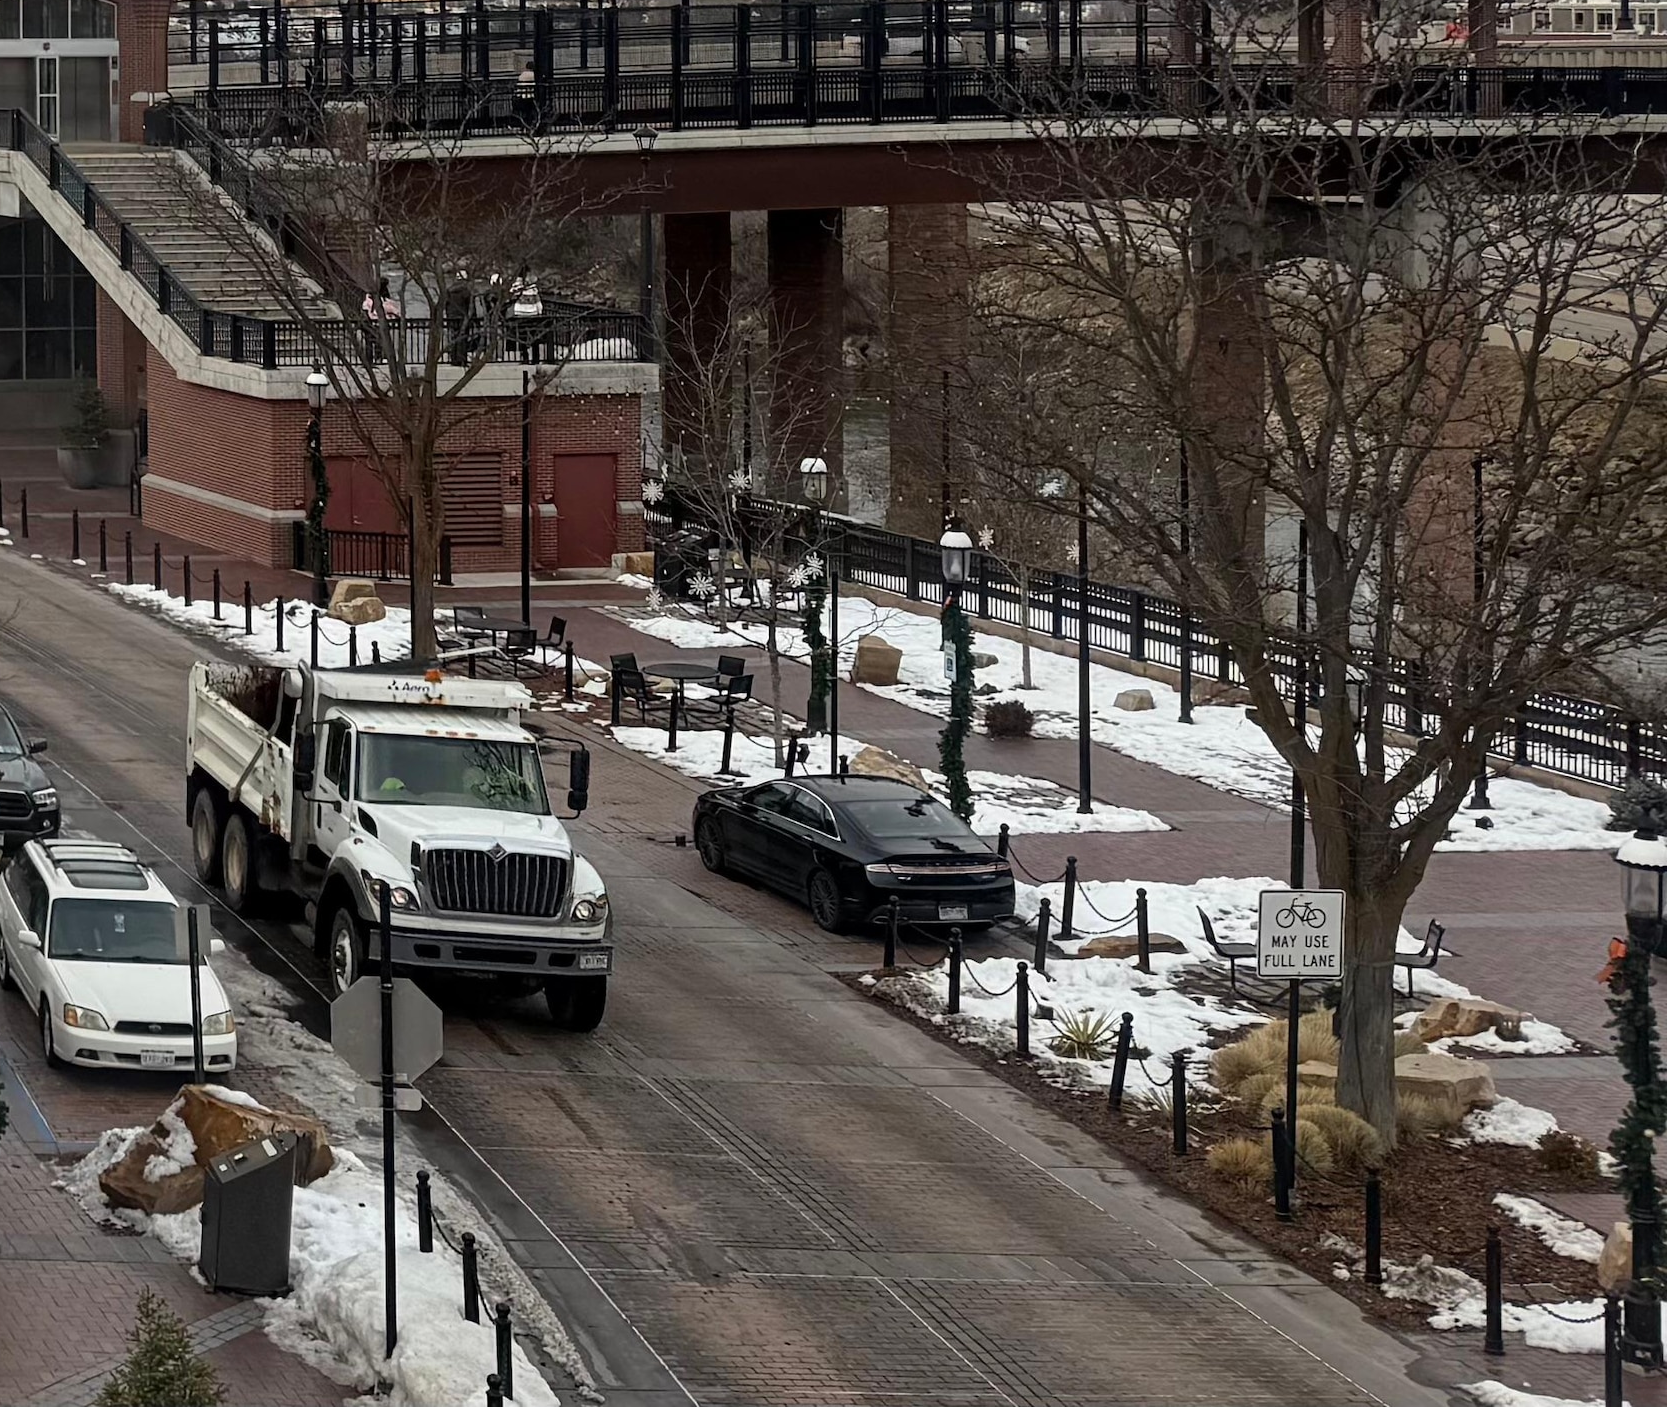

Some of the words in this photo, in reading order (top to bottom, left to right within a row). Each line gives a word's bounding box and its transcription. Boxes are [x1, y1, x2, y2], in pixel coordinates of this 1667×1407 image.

[1271, 935, 1297, 948] MAY
[1305, 935, 1329, 948] USE
[1264, 955, 1295, 968] FULL
[1303, 954, 1335, 967] LANE
